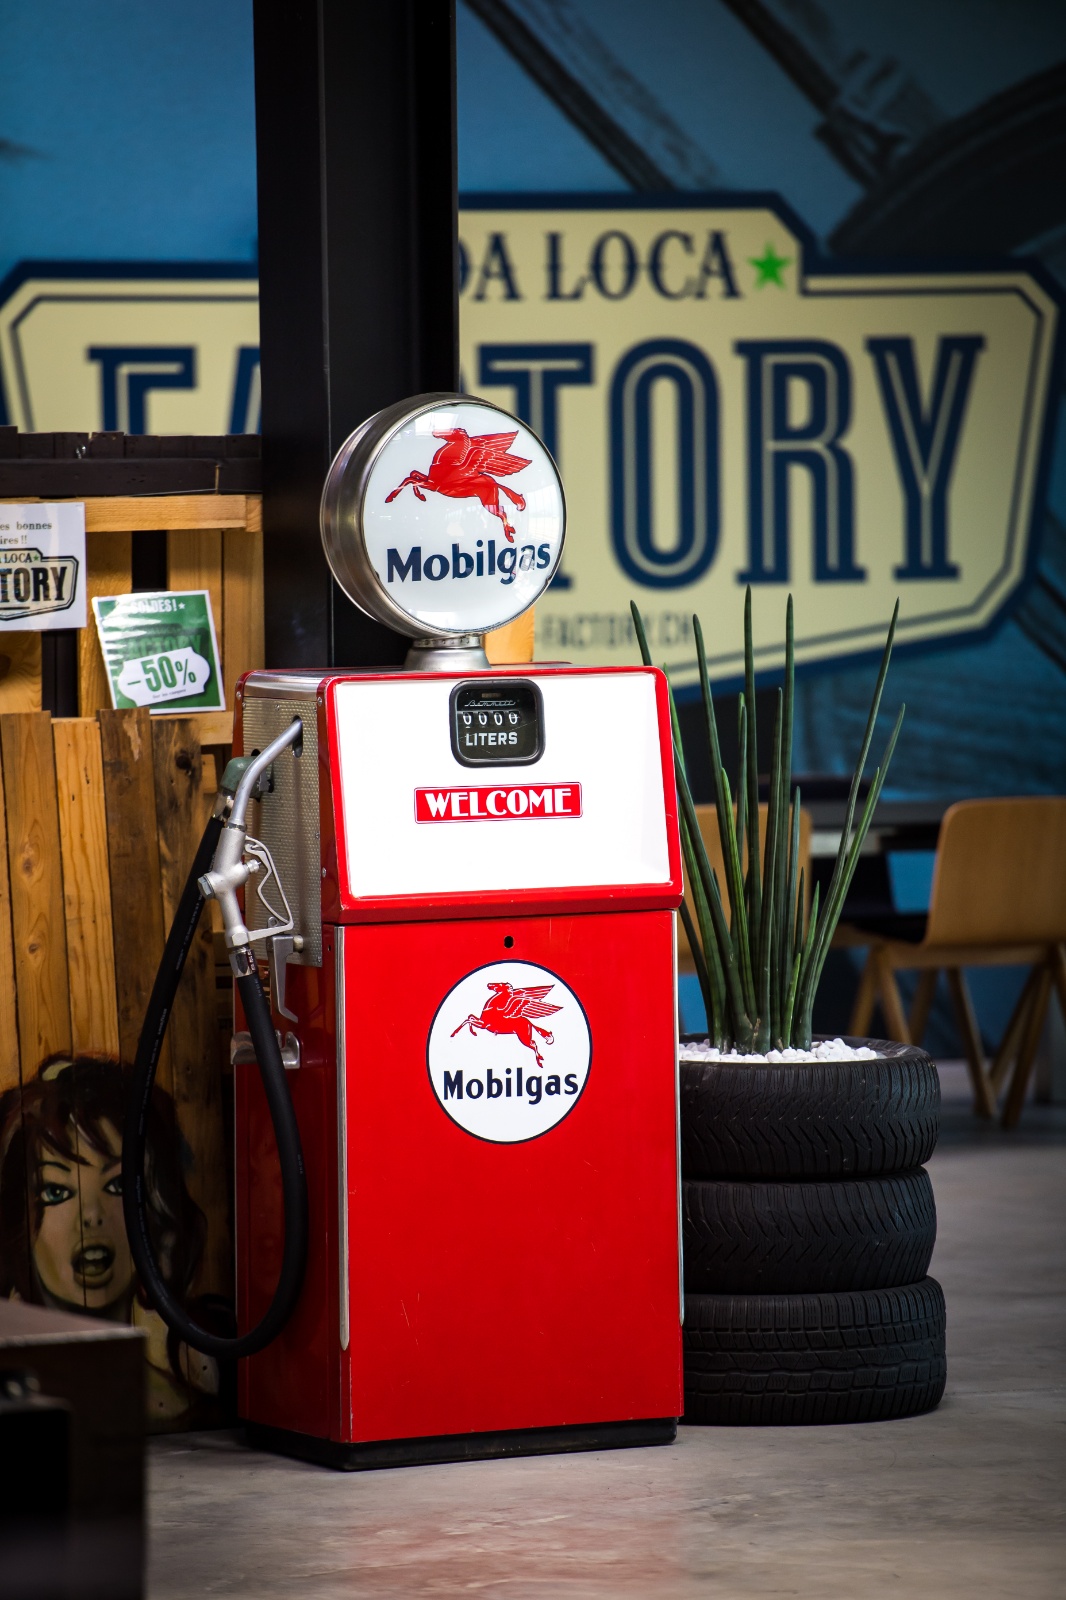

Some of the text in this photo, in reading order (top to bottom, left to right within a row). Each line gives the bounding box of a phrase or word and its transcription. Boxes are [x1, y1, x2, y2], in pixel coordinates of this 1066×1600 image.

[544, 230, 743, 300] LOCA
[86, 334, 987, 590] TORY
[16, 521, 53, 531] bonnes
[4, 553, 33, 564] LOCA
[386, 539, 551, 585] Mobilgas
[127, 655, 197, 692] -50%
[465, 732, 518, 746] LITERS
[424, 787, 572, 818] WELCOME
[443, 1067, 579, 1105] Mobilgas
